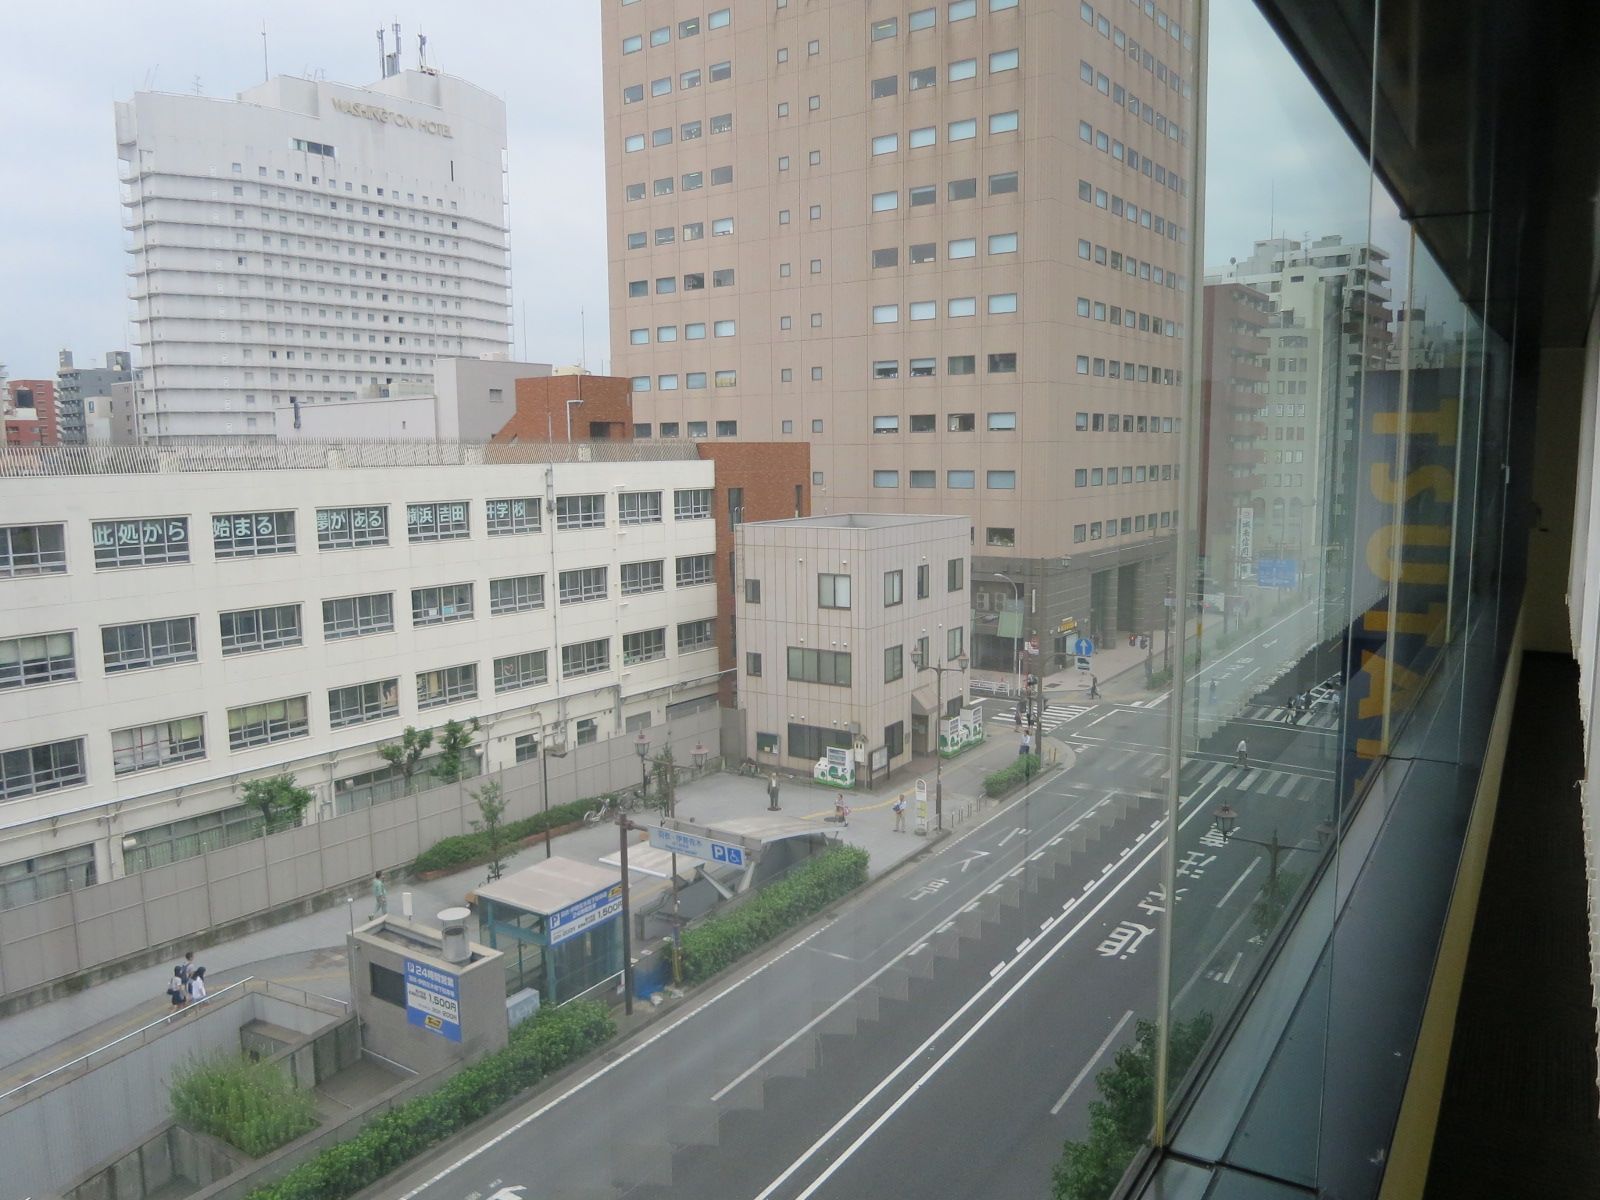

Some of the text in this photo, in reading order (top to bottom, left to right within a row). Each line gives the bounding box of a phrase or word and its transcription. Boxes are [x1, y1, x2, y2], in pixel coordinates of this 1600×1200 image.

[331, 98, 454, 139] WASHINGTON HOTEL
[93, 521, 185, 546] 此処から
[212, 515, 272, 538] 始まる
[316, 510, 382, 531] 夢がある
[486, 501, 525, 519] 中学校
[1353, 398, 1458, 794] TSUTA
[714, 845, 724, 856] P
